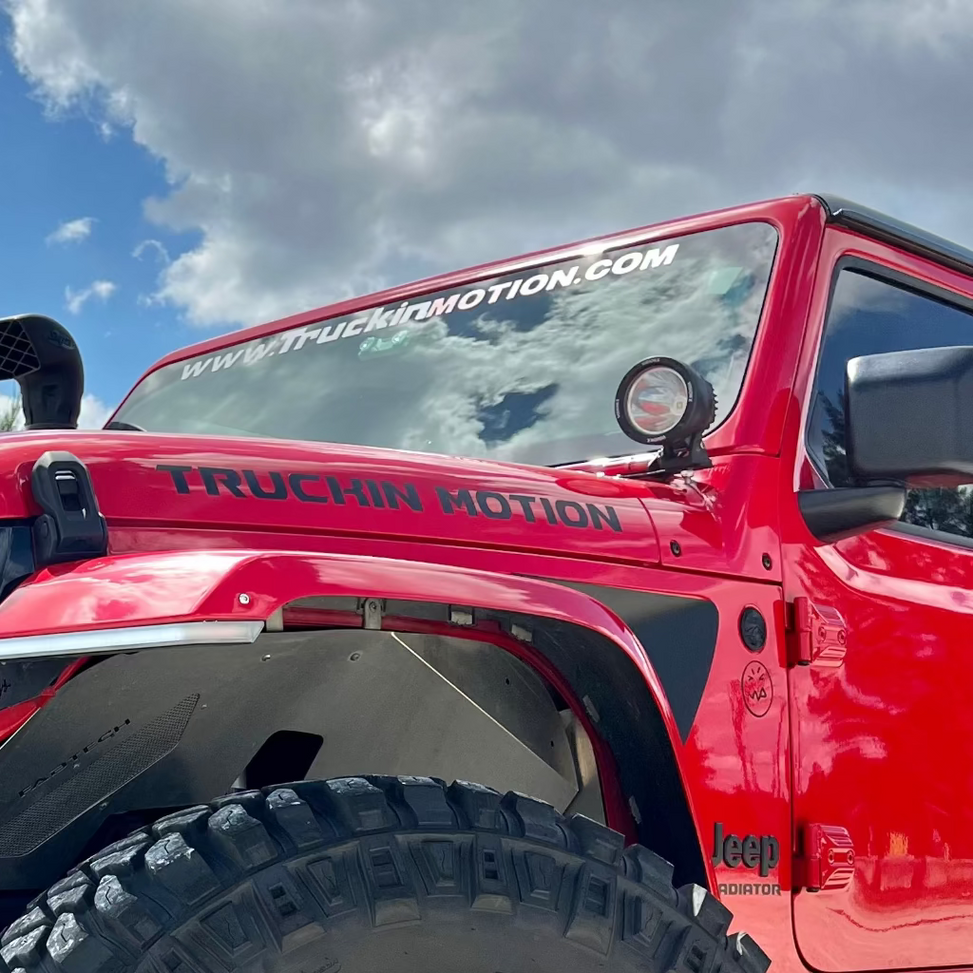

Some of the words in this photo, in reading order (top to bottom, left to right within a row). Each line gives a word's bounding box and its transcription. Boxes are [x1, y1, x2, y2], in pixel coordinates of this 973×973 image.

[435, 486, 623, 533] MOTION
[711, 821, 780, 877] Jeep
[718, 883, 781, 896] ADIATOR
